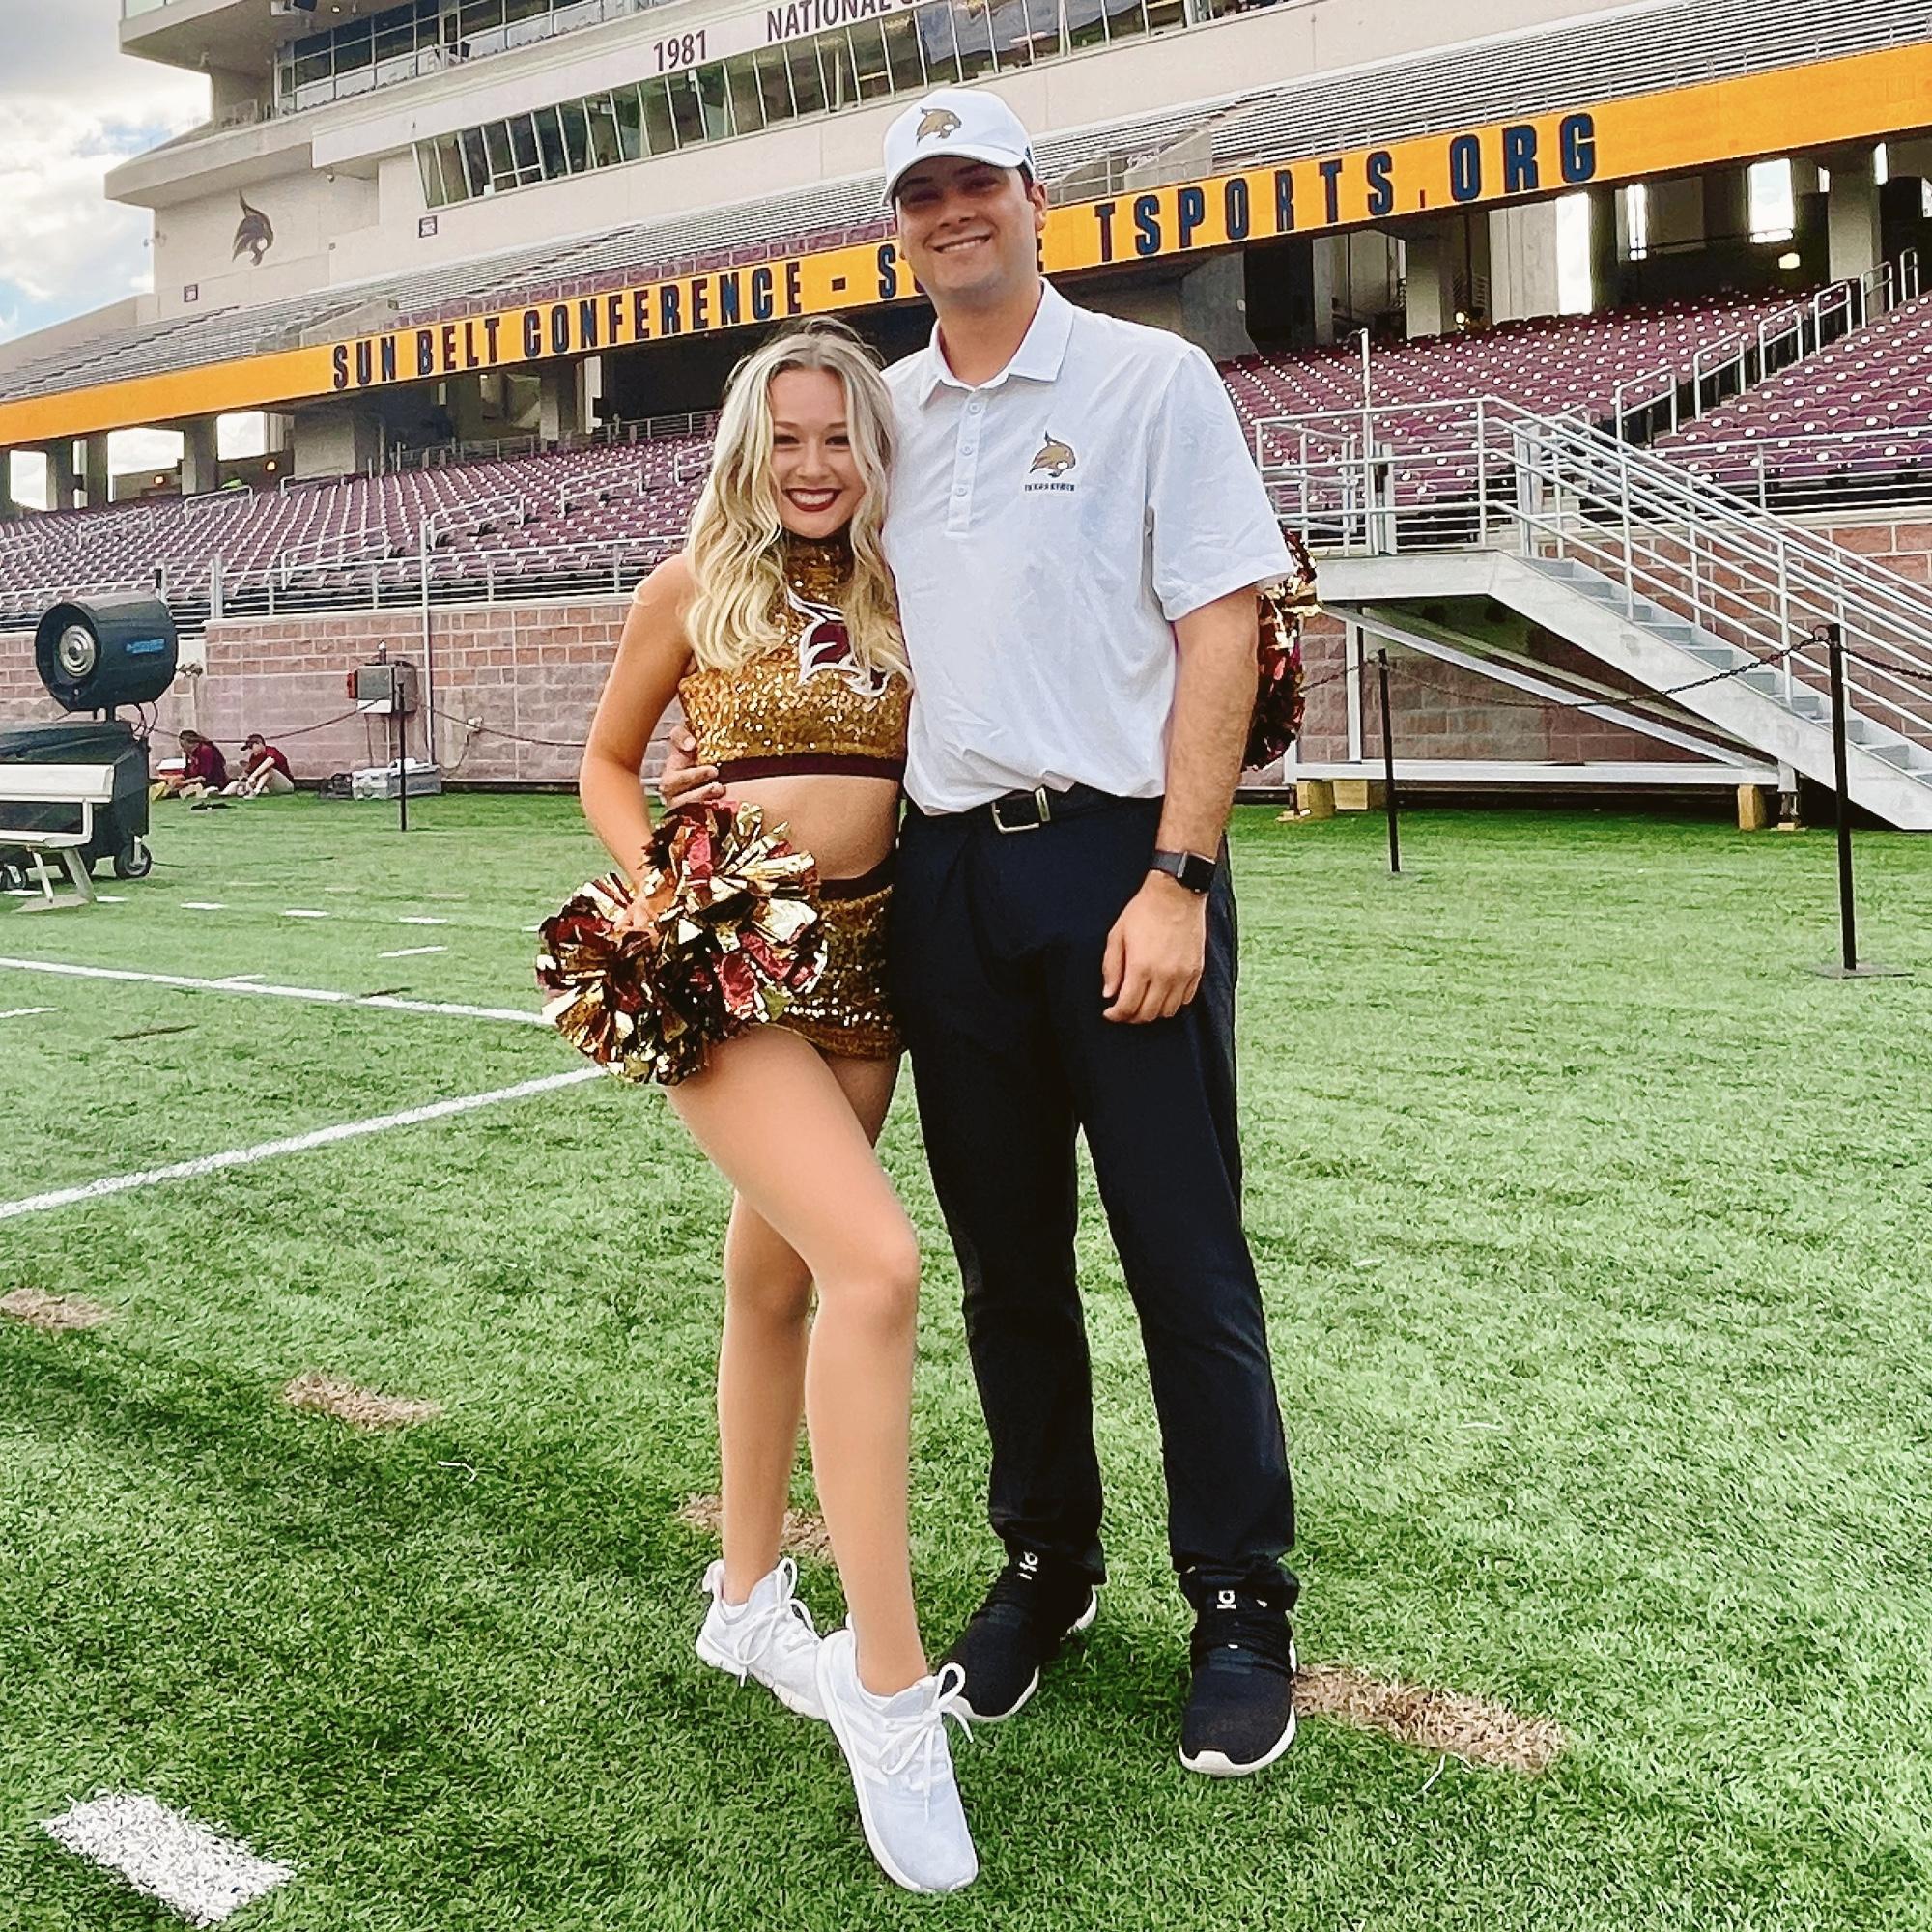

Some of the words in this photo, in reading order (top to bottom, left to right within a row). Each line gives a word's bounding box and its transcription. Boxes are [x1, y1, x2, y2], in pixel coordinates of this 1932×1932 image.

[653, 29, 707, 71] 1981
[333, 335, 396, 389] SUN
[416, 317, 500, 376] BELT
[523, 261, 802, 357] CONFERENCE
